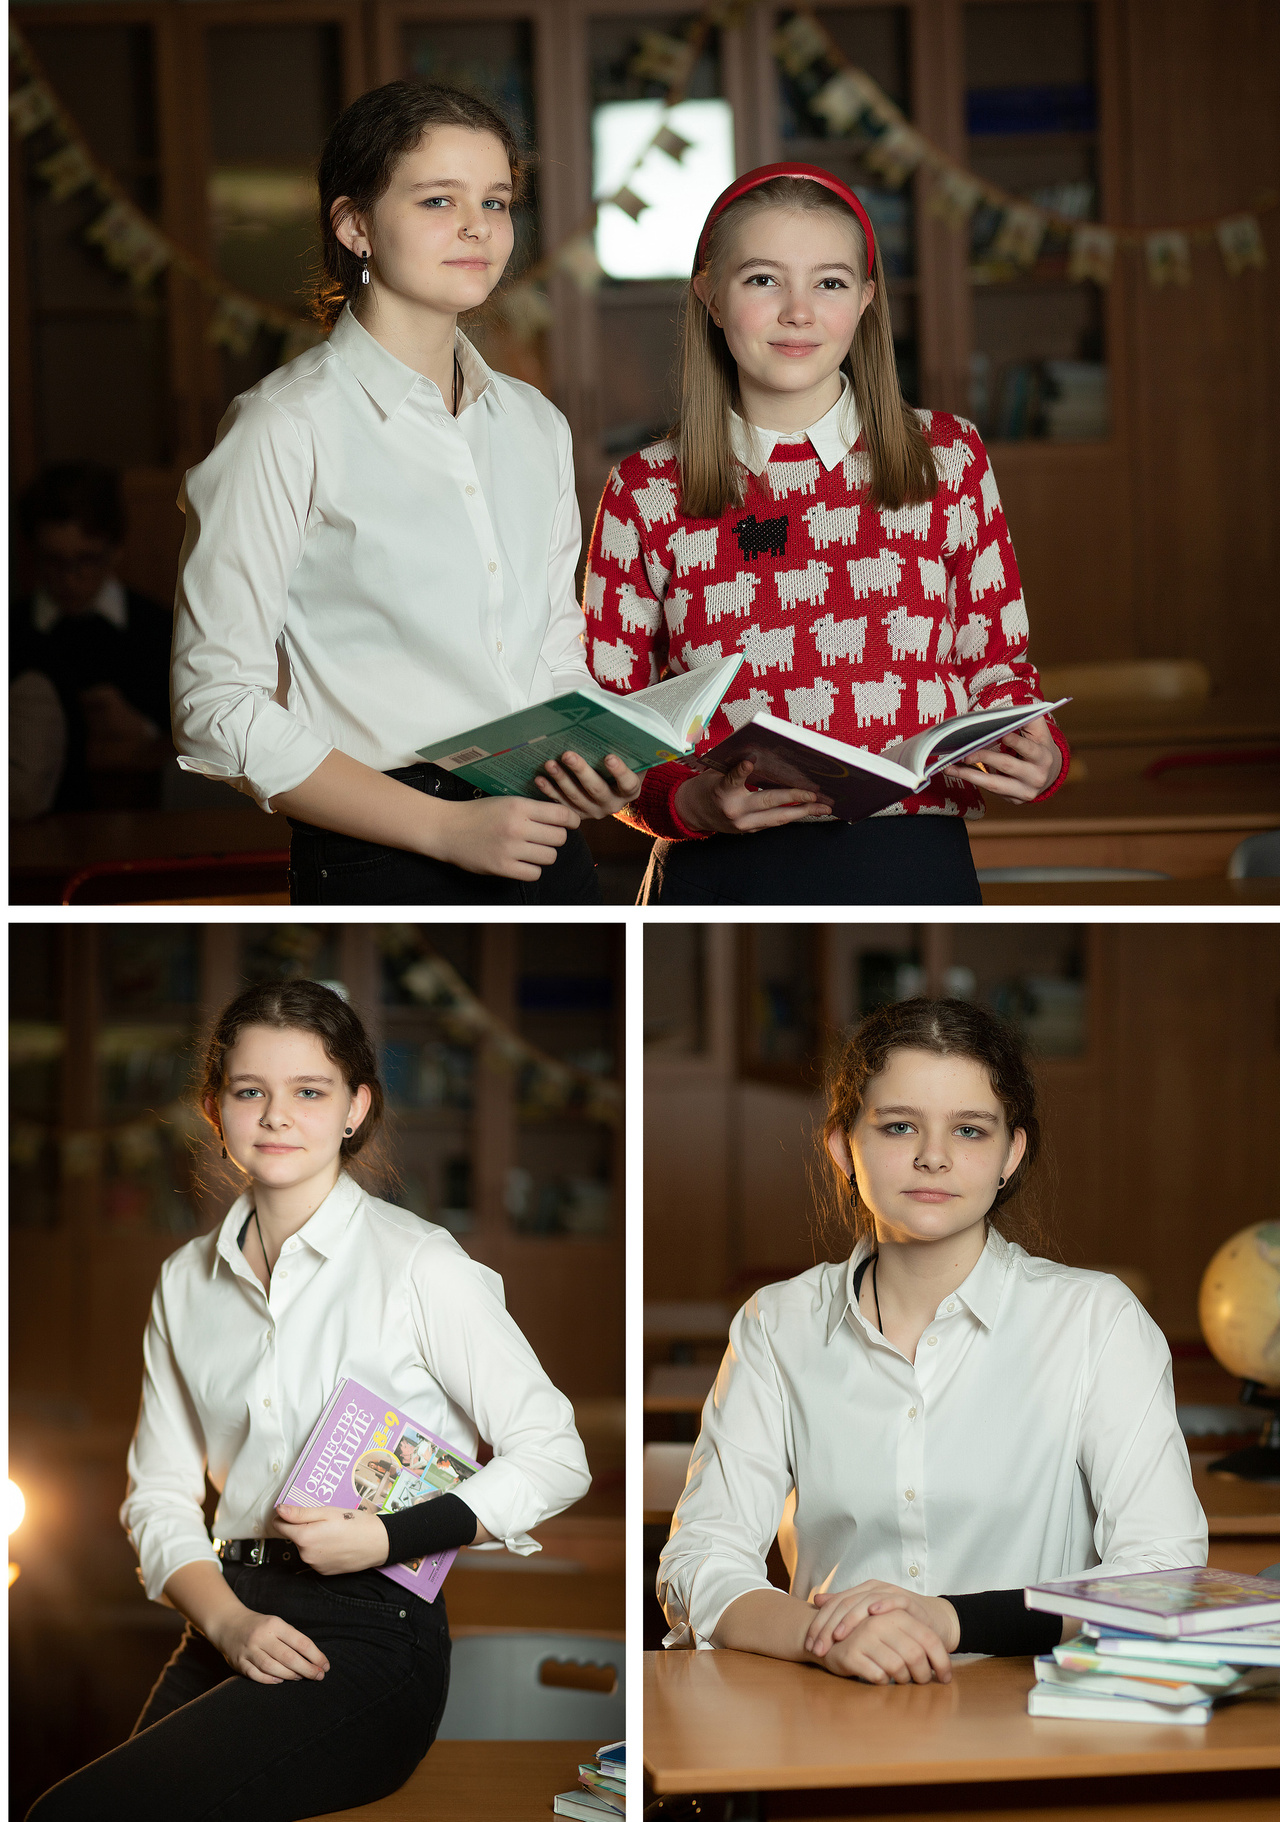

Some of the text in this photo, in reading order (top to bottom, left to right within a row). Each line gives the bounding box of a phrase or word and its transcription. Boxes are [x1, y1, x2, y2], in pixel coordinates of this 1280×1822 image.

[305, 1399, 358, 1493] ОБЩЕСТВО-
[315, 1409, 375, 1503] ЗНАНИЕ
[373, 1411, 400, 1447] 8-9
